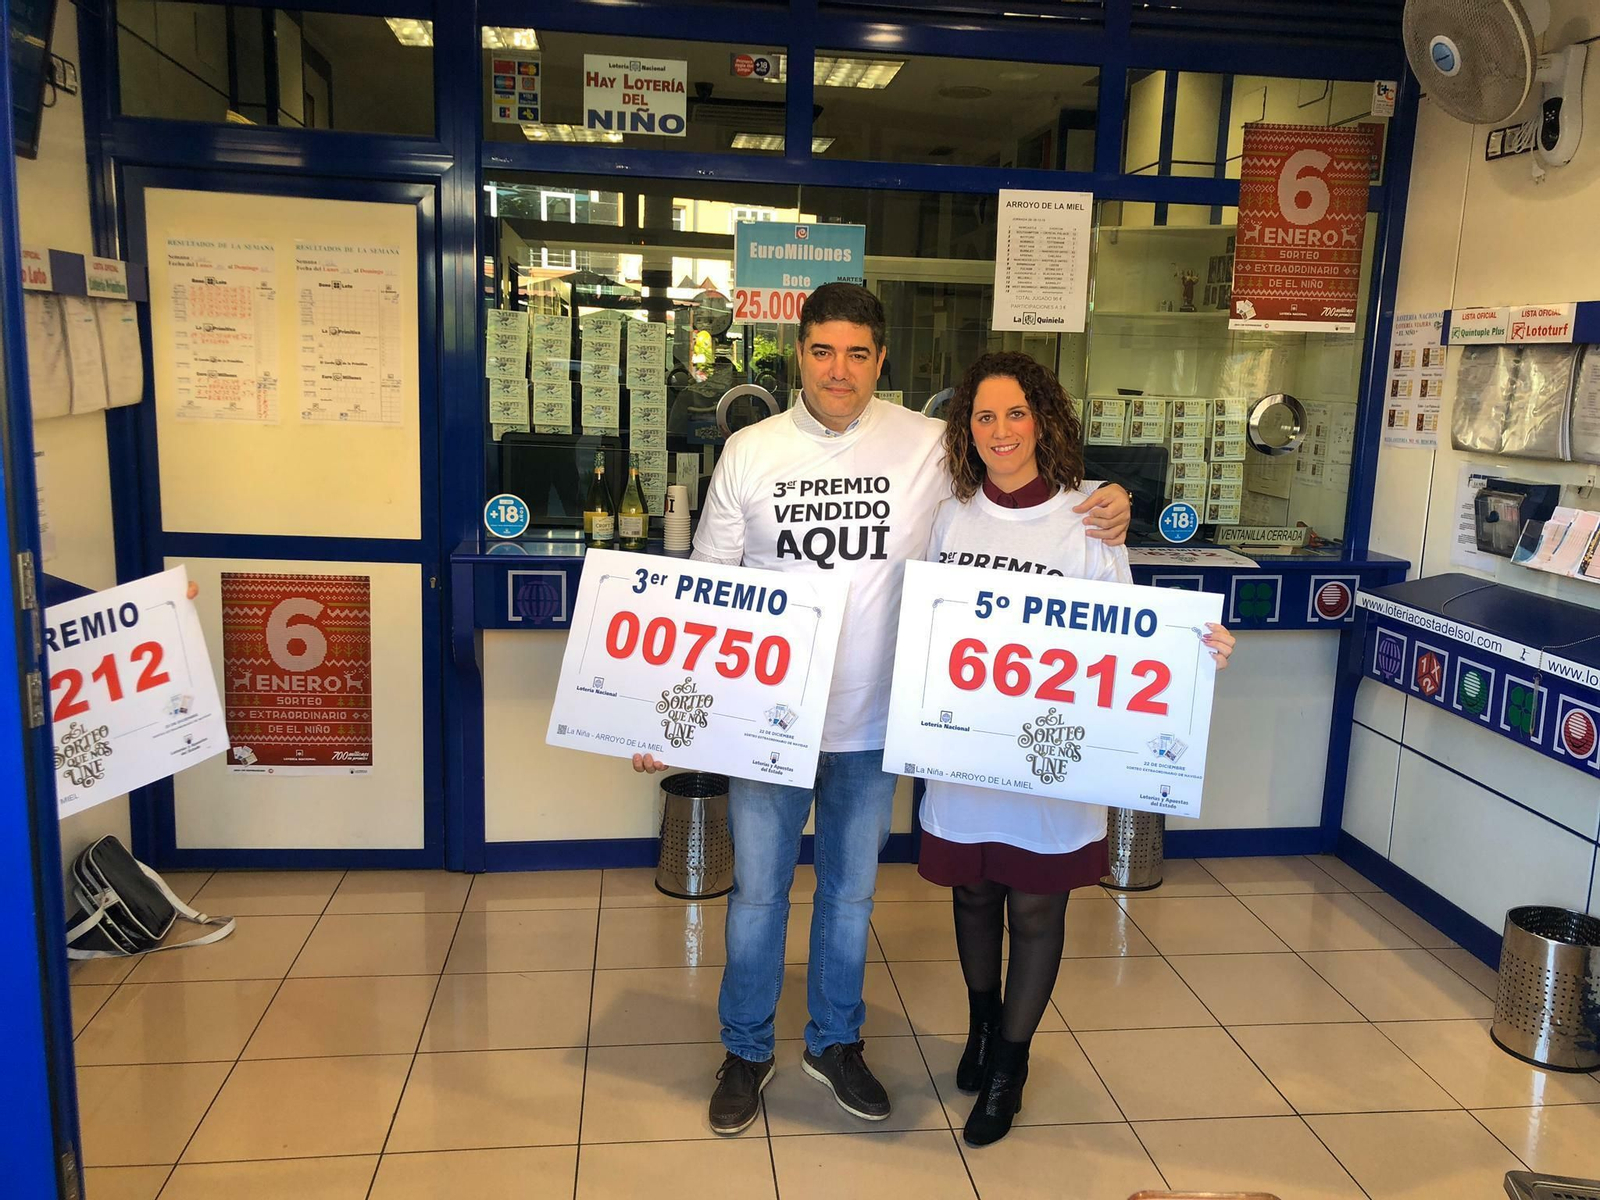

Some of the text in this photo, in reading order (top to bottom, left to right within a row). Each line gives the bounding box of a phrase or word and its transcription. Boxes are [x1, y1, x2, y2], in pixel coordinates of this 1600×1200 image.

[586, 71, 686, 94] HAY LOTERÍA
[622, 93, 648, 106] DEL
[587, 107, 686, 134] NIÑO
[1277, 148, 1332, 226] 6
[1006, 201, 1040, 209] ARROYO
[1042, 202, 1052, 210] DE
[1264, 228, 1339, 246] ENERO
[244, 244, 275, 252] SEMANA
[296, 244, 342, 252] RESULTADOS
[370, 248, 400, 256] SEMANA
[750, 242, 852, 262] EuroMillones
[1280, 250, 1320, 260] SORTEO
[1254, 264, 1340, 275] EXTRAORDINARIO
[782, 274, 812, 288] Bote
[1268, 278, 1324, 289] DE EL NIÑO
[735, 290, 808, 320] 25.000
[1320, 306, 1336, 317] 700
[1036, 316, 1064, 324] Quiniela
[1522, 310, 1538, 318] LISTA
[1460, 327, 1505, 338] Quintuple Plus
[1526, 323, 1569, 337] Lototurf
[772, 476, 890, 498] 3er PREMIO
[490, 506, 519, 523] +18
[774, 500, 890, 523] VENDIDO
[1164, 512, 1190, 528] +18
[1220, 528, 1303, 541] VENTANILLA CERRADA
[776, 519, 890, 570] AQUÍ
[632, 568, 788, 616] 3er PREMIO
[1022, 596, 1158, 638] PREMIO
[1362, 596, 1503, 652] www.loteriacostadelsol.com
[266, 596, 328, 672] 6
[605, 610, 792, 686] 00750
[256, 674, 342, 692] ENERO
[672, 676, 698, 694] EL
[948, 637, 1172, 717] 66212
[1422, 678, 1435, 691] 2
[276, 696, 322, 706] SORTEO
[595, 688, 618, 698] Nacional
[656, 690, 714, 714] SORTEO
[250, 710, 347, 720] EXTRAORDINARIO
[668, 708, 708, 728] QUE NOS
[1035, 706, 1065, 727] EL
[268, 724, 330, 734] DE EL NIÑO
[660, 718, 696, 749] UNE
[772, 731, 795, 740] DICIEMBRE
[944, 723, 970, 732] Nacional
[1018, 722, 1086, 749] SORTEO
[566, 726, 664, 753] La Niña ARROYO DE LA MIEL
[67, 740, 113, 768] QUE NOS
[331, 751, 349, 761] 700
[1033, 742, 1082, 762] QUE NOS
[63, 758, 105, 788] UNE
[768, 768, 783, 776] Estado
[774, 764, 794, 772] Apuestas
[1026, 754, 1068, 785] UNE
[1159, 763, 1186, 771] DICIEMBRE
[916, 765, 1034, 790] La Niña ARROYO DE LA MIEL
[1159, 802, 1177, 810] Estado
[1165, 798, 1188, 806] Apuestas
